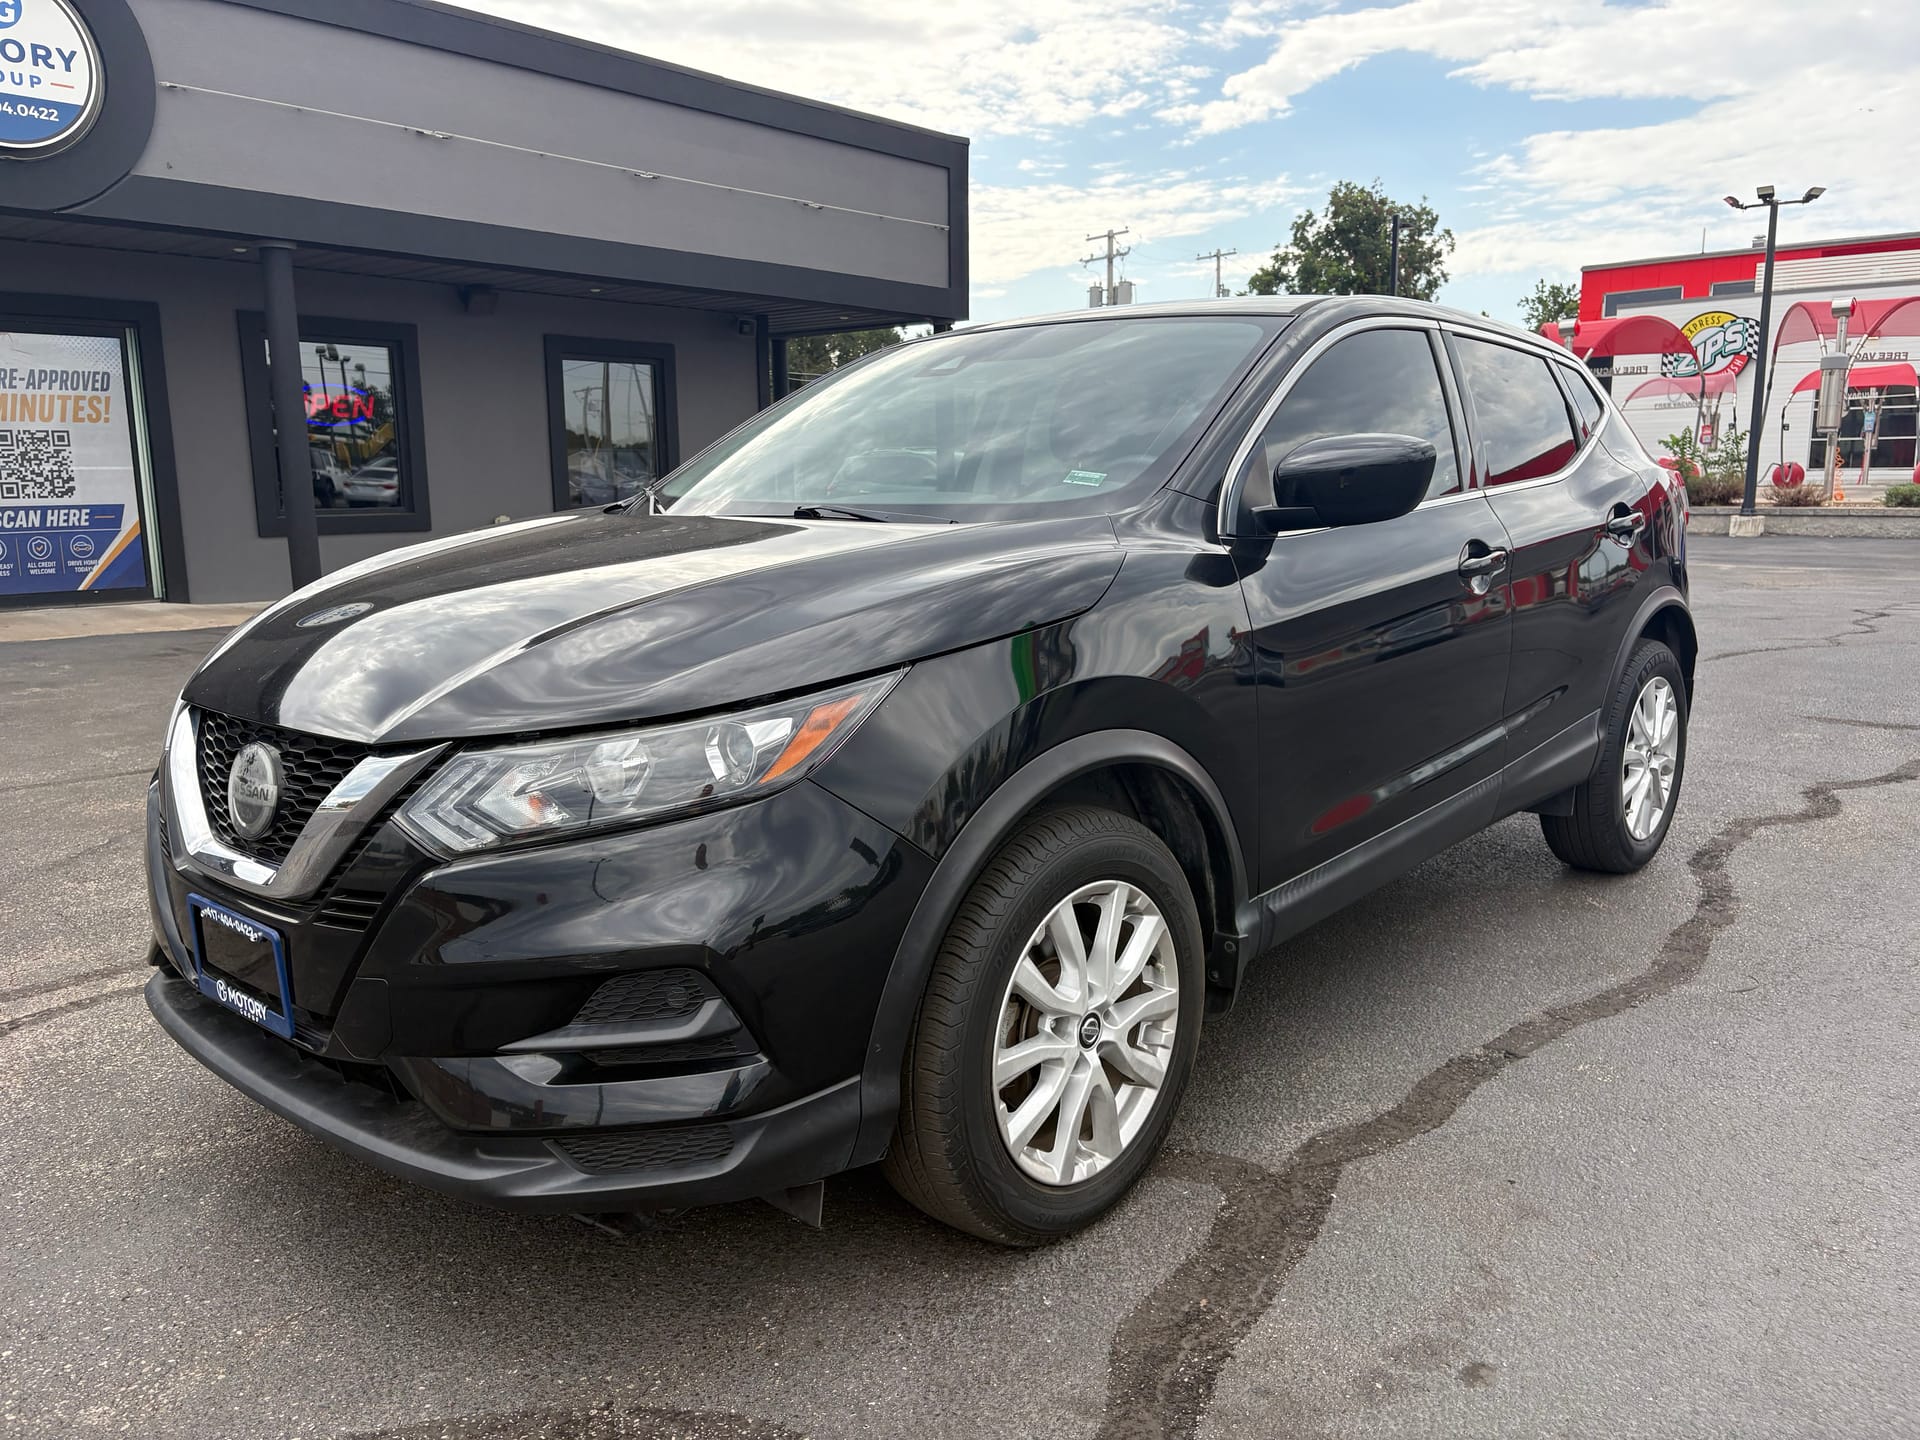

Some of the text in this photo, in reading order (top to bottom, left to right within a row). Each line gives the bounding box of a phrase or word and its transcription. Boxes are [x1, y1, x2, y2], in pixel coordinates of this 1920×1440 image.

[0, 101, 59, 122] 4.0422
[1685, 315, 1722, 339] XPRESS
[1674, 321, 1746, 375] ZIPS
[0, 368, 111, 392] RE-APPROVED
[304, 393, 375, 419] PEN
[0, 508, 90, 528] CAN HERE
[227, 987, 267, 1021] MOTORY
